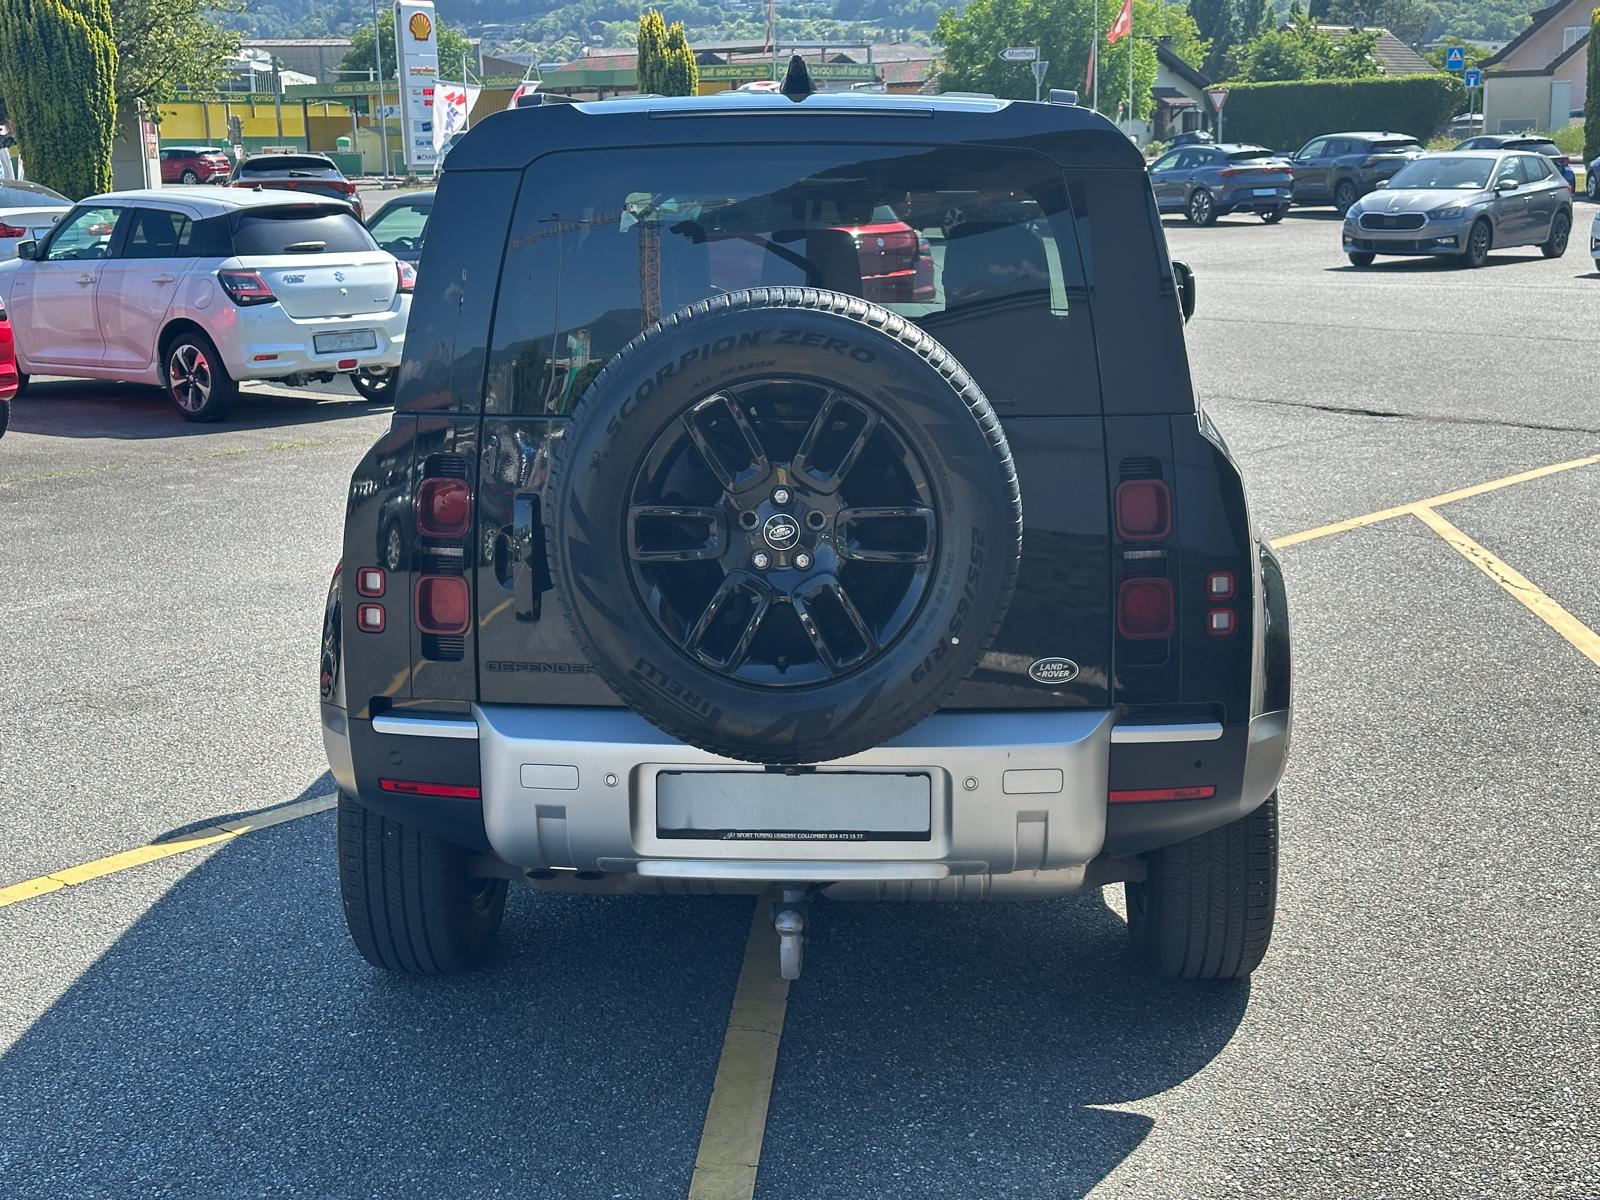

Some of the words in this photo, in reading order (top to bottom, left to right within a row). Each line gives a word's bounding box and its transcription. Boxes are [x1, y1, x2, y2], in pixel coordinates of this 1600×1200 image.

[606, 330, 764, 435] SCORPION
[774, 329, 877, 364] ZERO
[948, 525, 985, 634] 255/65
[628, 657, 723, 729] PIRELLI
[910, 636, 949, 685] R19
